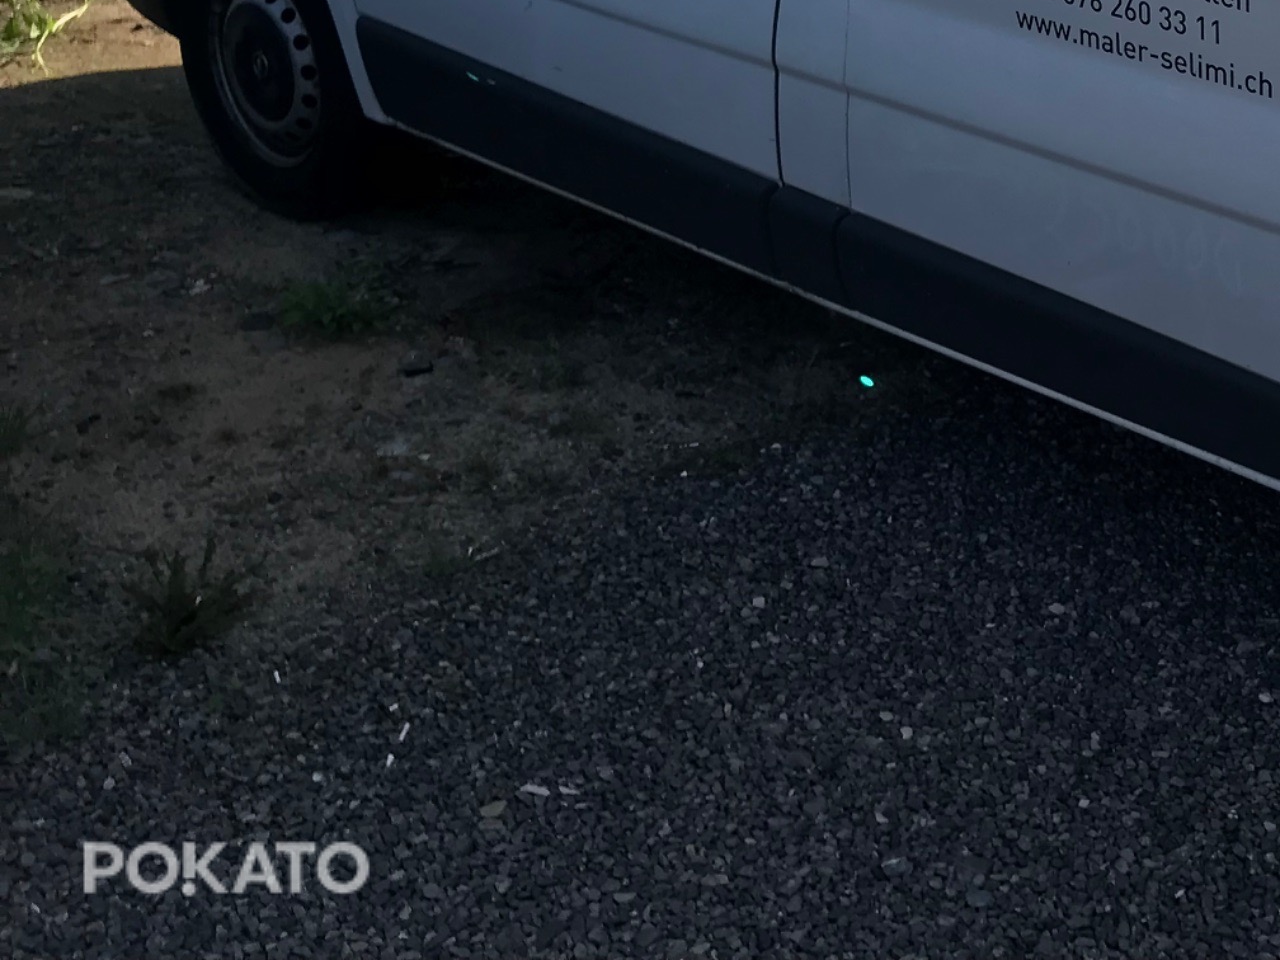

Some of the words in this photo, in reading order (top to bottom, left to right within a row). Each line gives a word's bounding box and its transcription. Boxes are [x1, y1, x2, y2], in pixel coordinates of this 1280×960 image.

[1015, 10, 1274, 99] www.maler-selimi.ch
[1158, 5, 1187, 36] 33
[1195, 15, 1221, 46] 11
